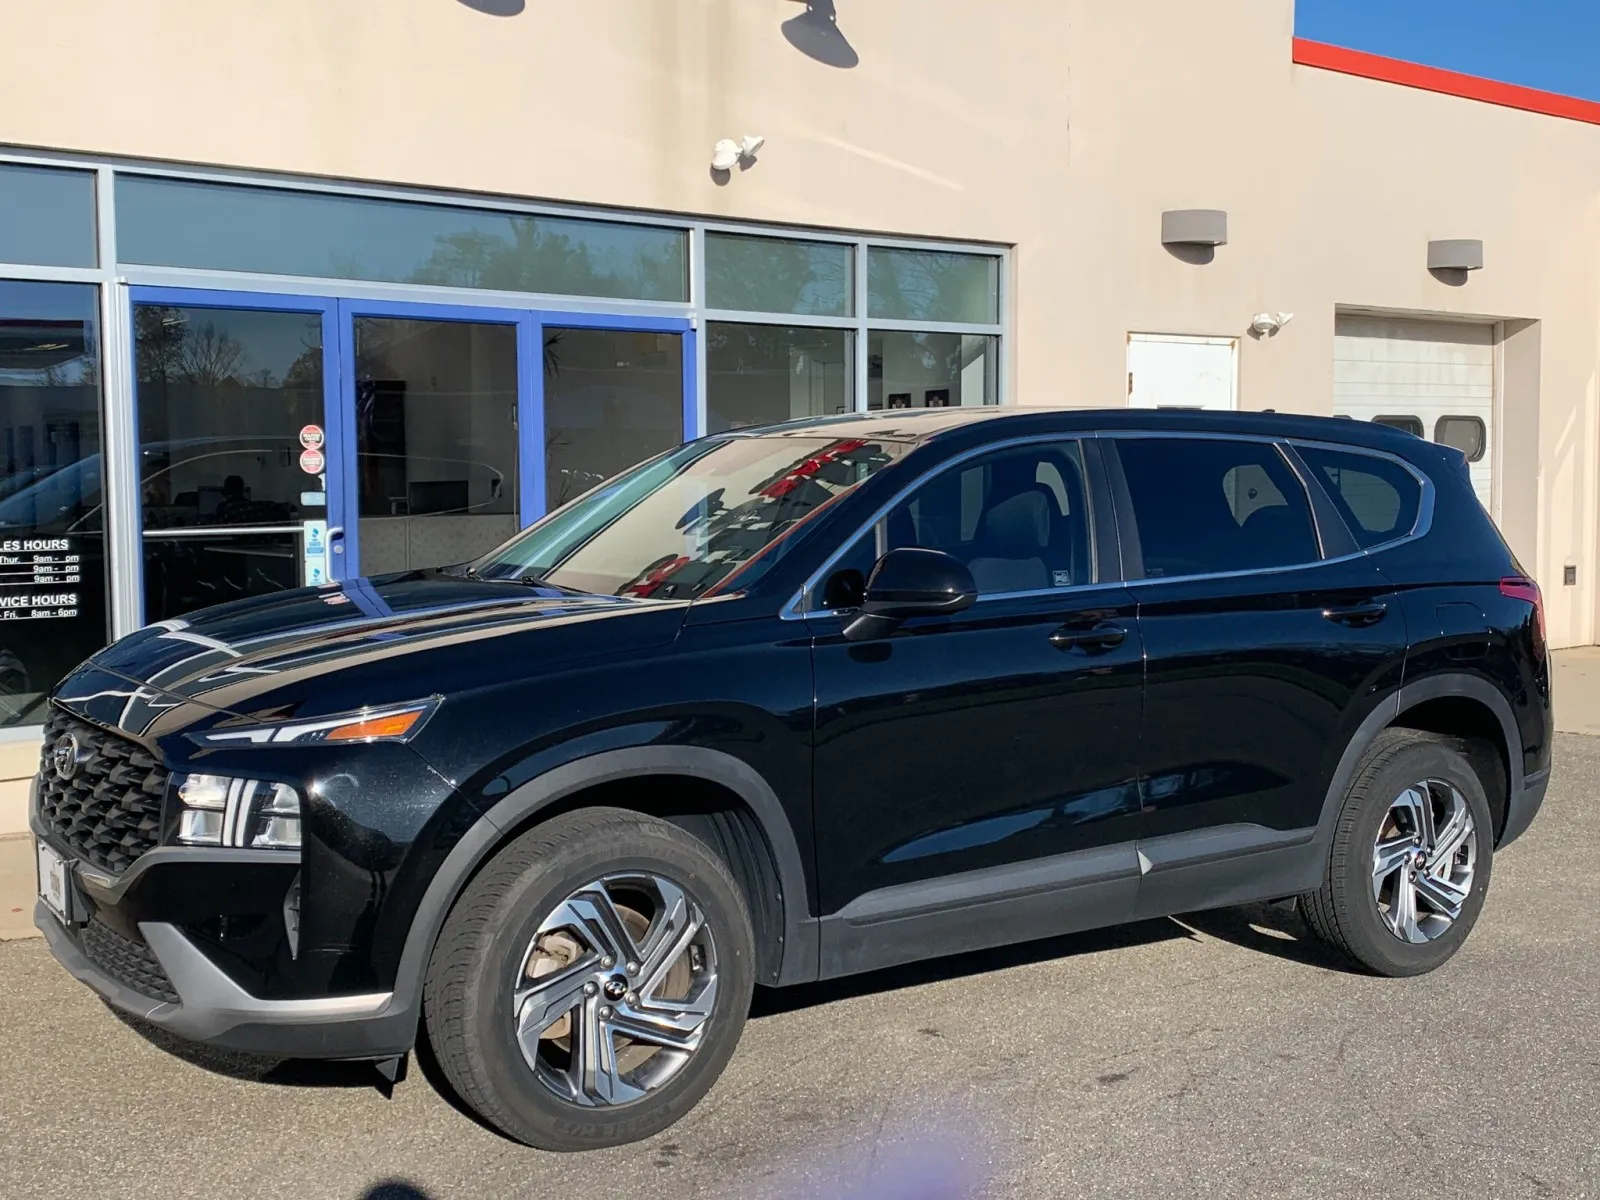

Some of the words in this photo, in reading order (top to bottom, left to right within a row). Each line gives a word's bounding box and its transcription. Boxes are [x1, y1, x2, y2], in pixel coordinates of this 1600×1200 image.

[24, 540, 69, 550] HOURS
[33, 555, 53, 563] 9am
[65, 555, 80, 563] pm
[33, 565, 53, 573] 9am
[65, 565, 80, 573] pm
[34, 575, 54, 583] 9am
[66, 575, 80, 583] pm
[32, 594, 77, 605] HOURS
[31, 609, 51, 617] 8am
[58, 608, 77, 617] 6pm
